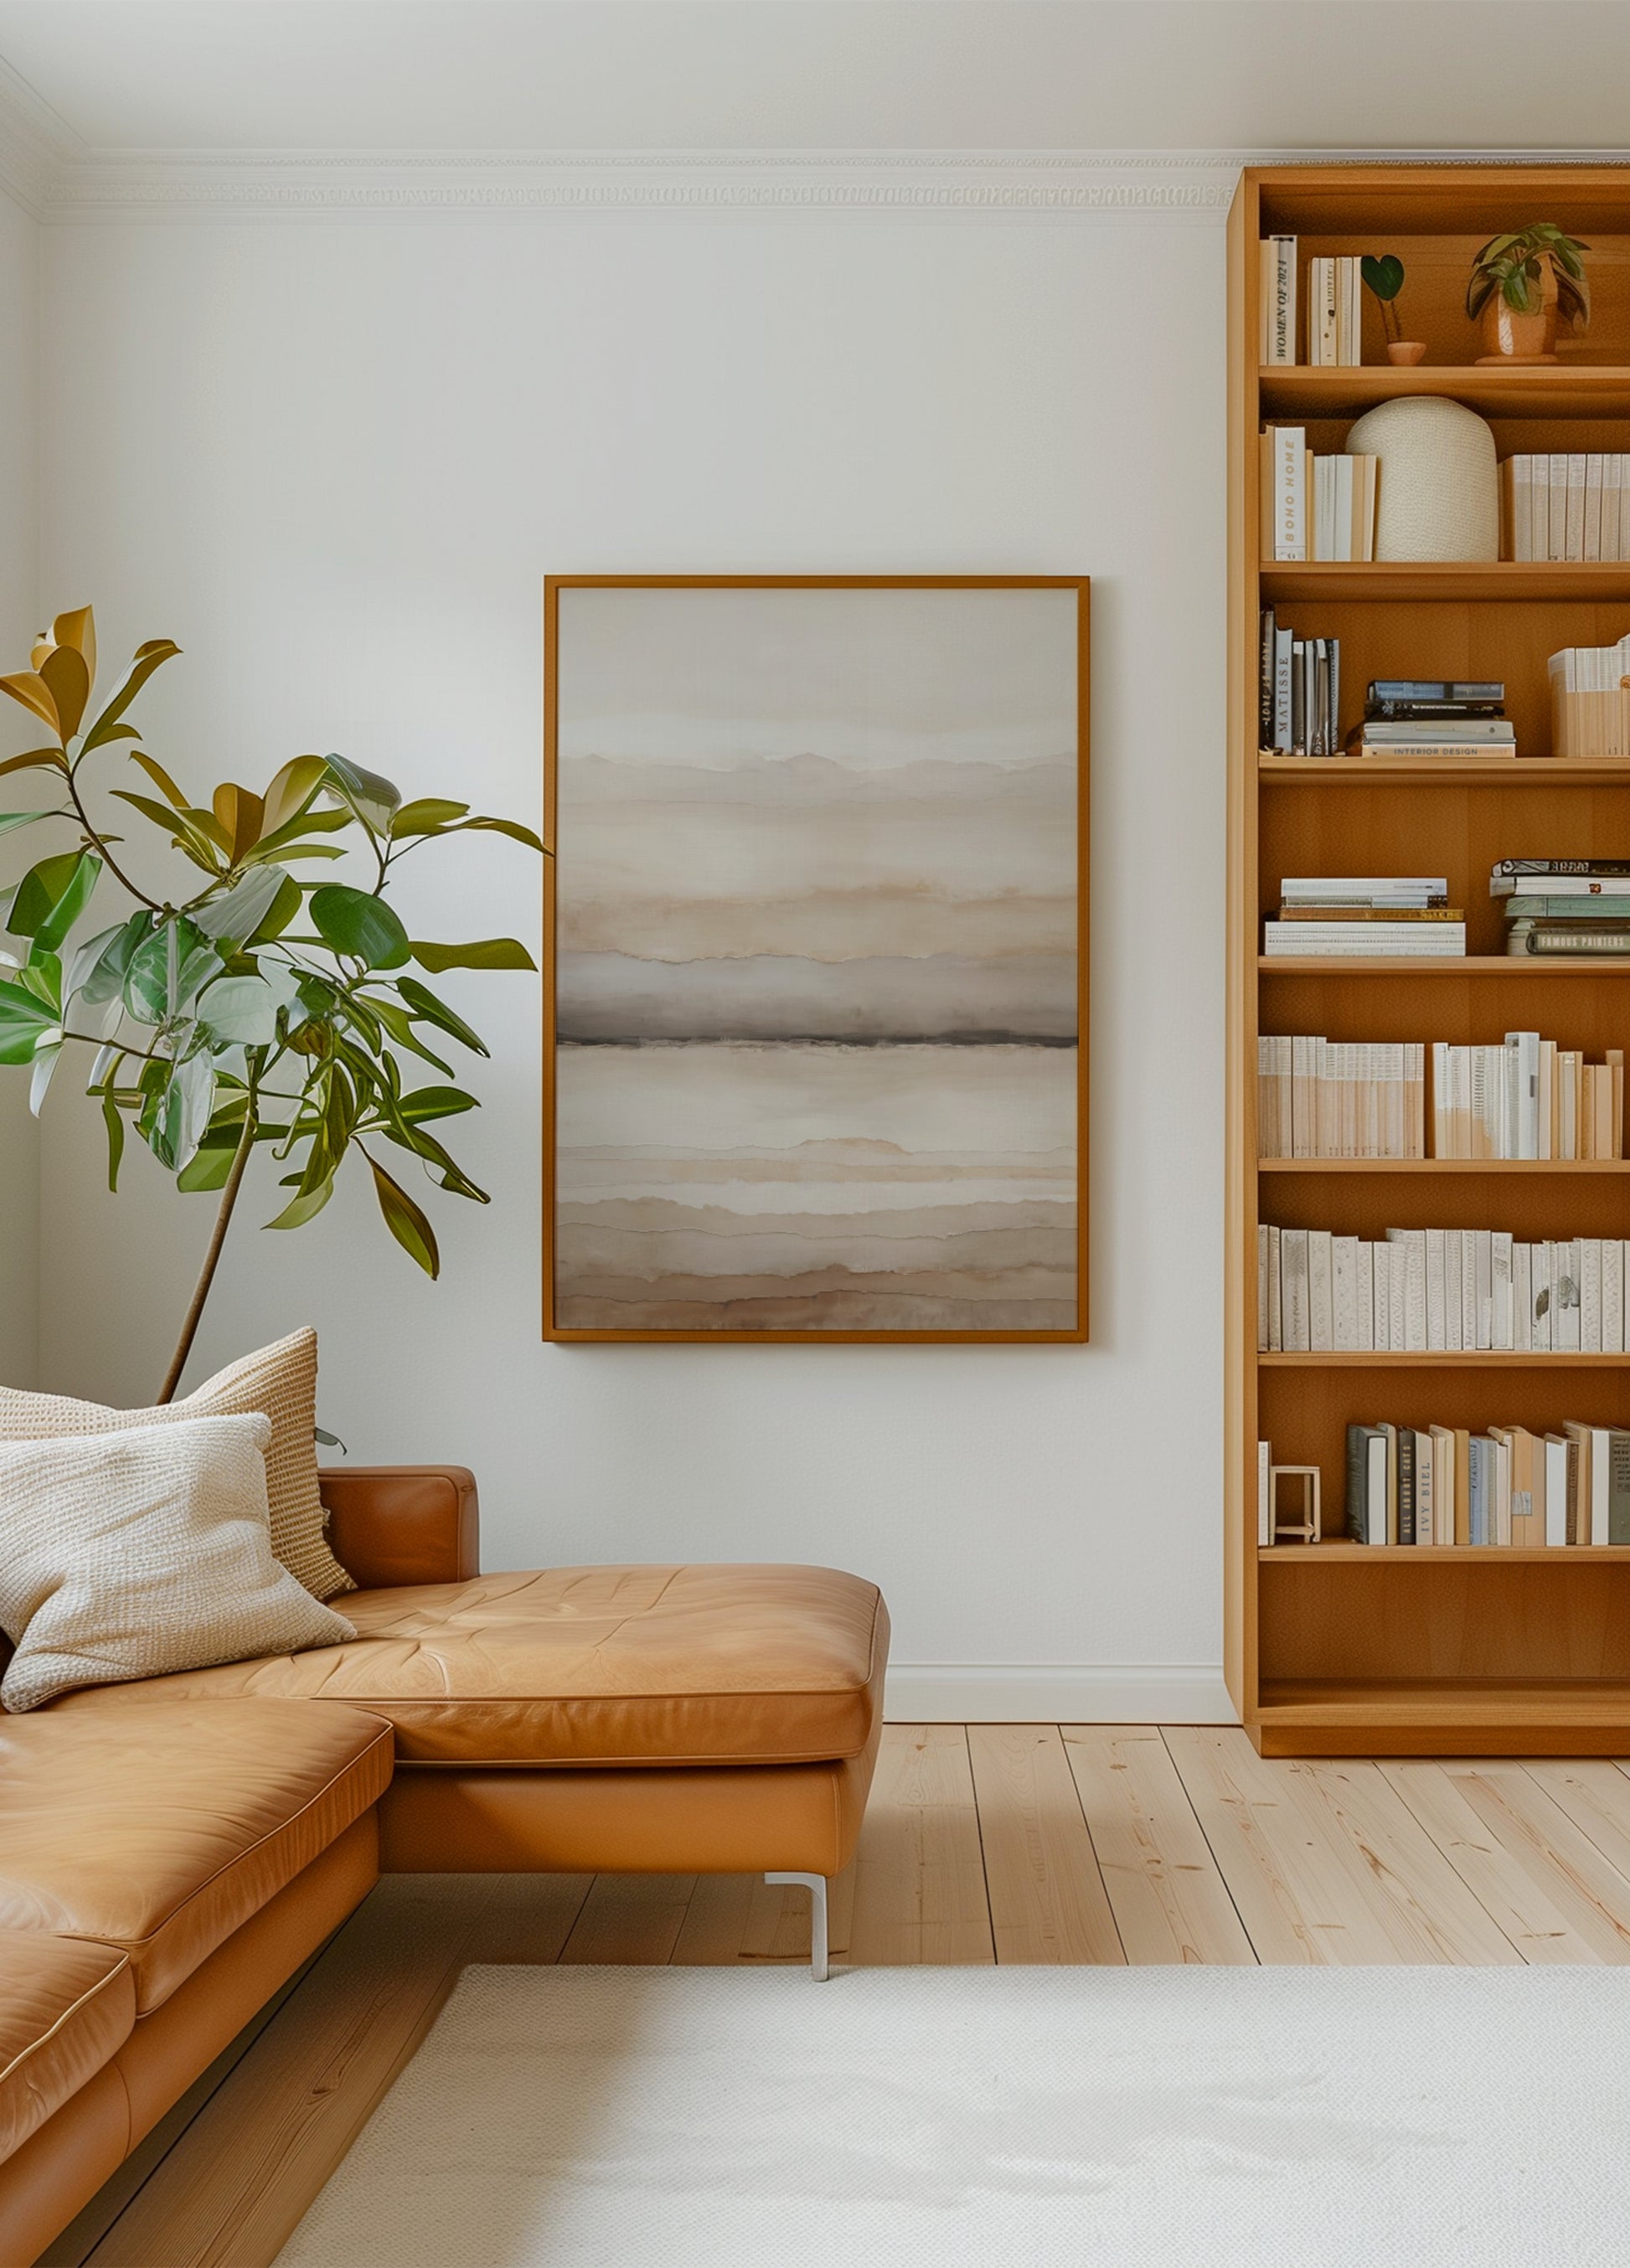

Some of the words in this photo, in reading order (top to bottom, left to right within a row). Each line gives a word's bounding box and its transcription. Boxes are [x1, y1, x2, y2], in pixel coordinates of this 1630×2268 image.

[1277, 260, 1287, 285] 2024
[1277, 286, 1287, 306] OF
[1277, 308, 1287, 358] WOMEN
[1285, 440, 1294, 487] HOME
[1285, 495, 1294, 543] BOHO
[1278, 657, 1287, 733] MATISSE
[1541, 937, 1577, 947] FAMOUS
[1581, 937, 1624, 947] PAINTERS
[1402, 1446, 1411, 1471] CATS
[1402, 1477, 1411, 1509] ABOUT
[1421, 1462, 1431, 1497] BIEL
[1402, 1515, 1411, 1533] ALL
[1421, 1506, 1430, 1532] IVY
